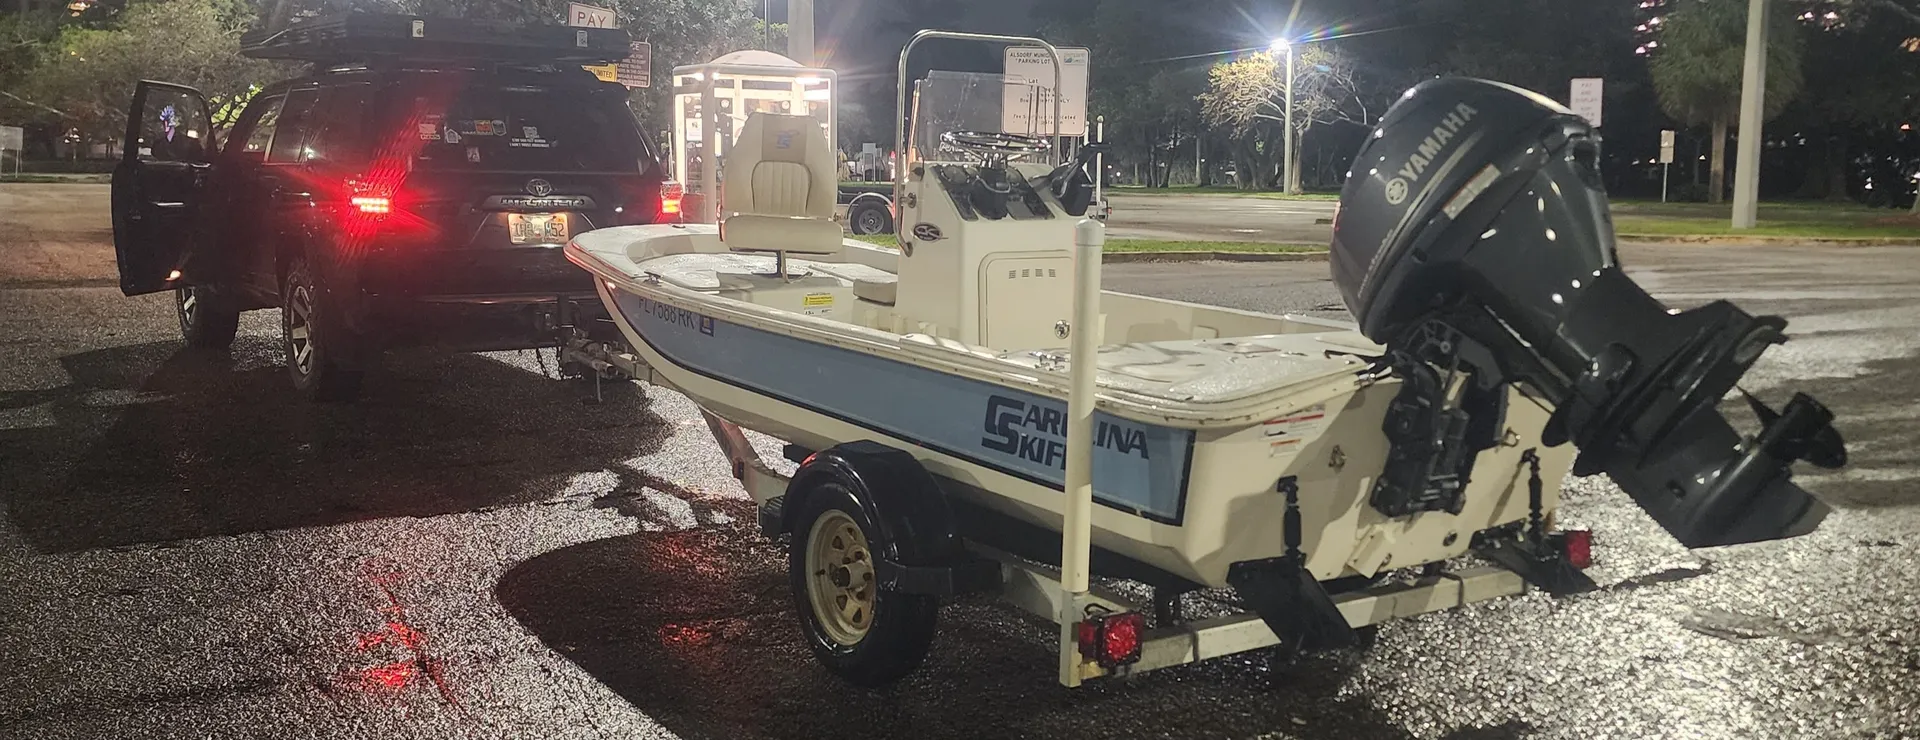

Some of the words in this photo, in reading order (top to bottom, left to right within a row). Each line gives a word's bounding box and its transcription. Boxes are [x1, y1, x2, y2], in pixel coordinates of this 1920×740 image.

[577, 11, 607, 28] PAY
[1399, 102, 1479, 182] YAMAHA
[678, 308, 695, 330] RK
